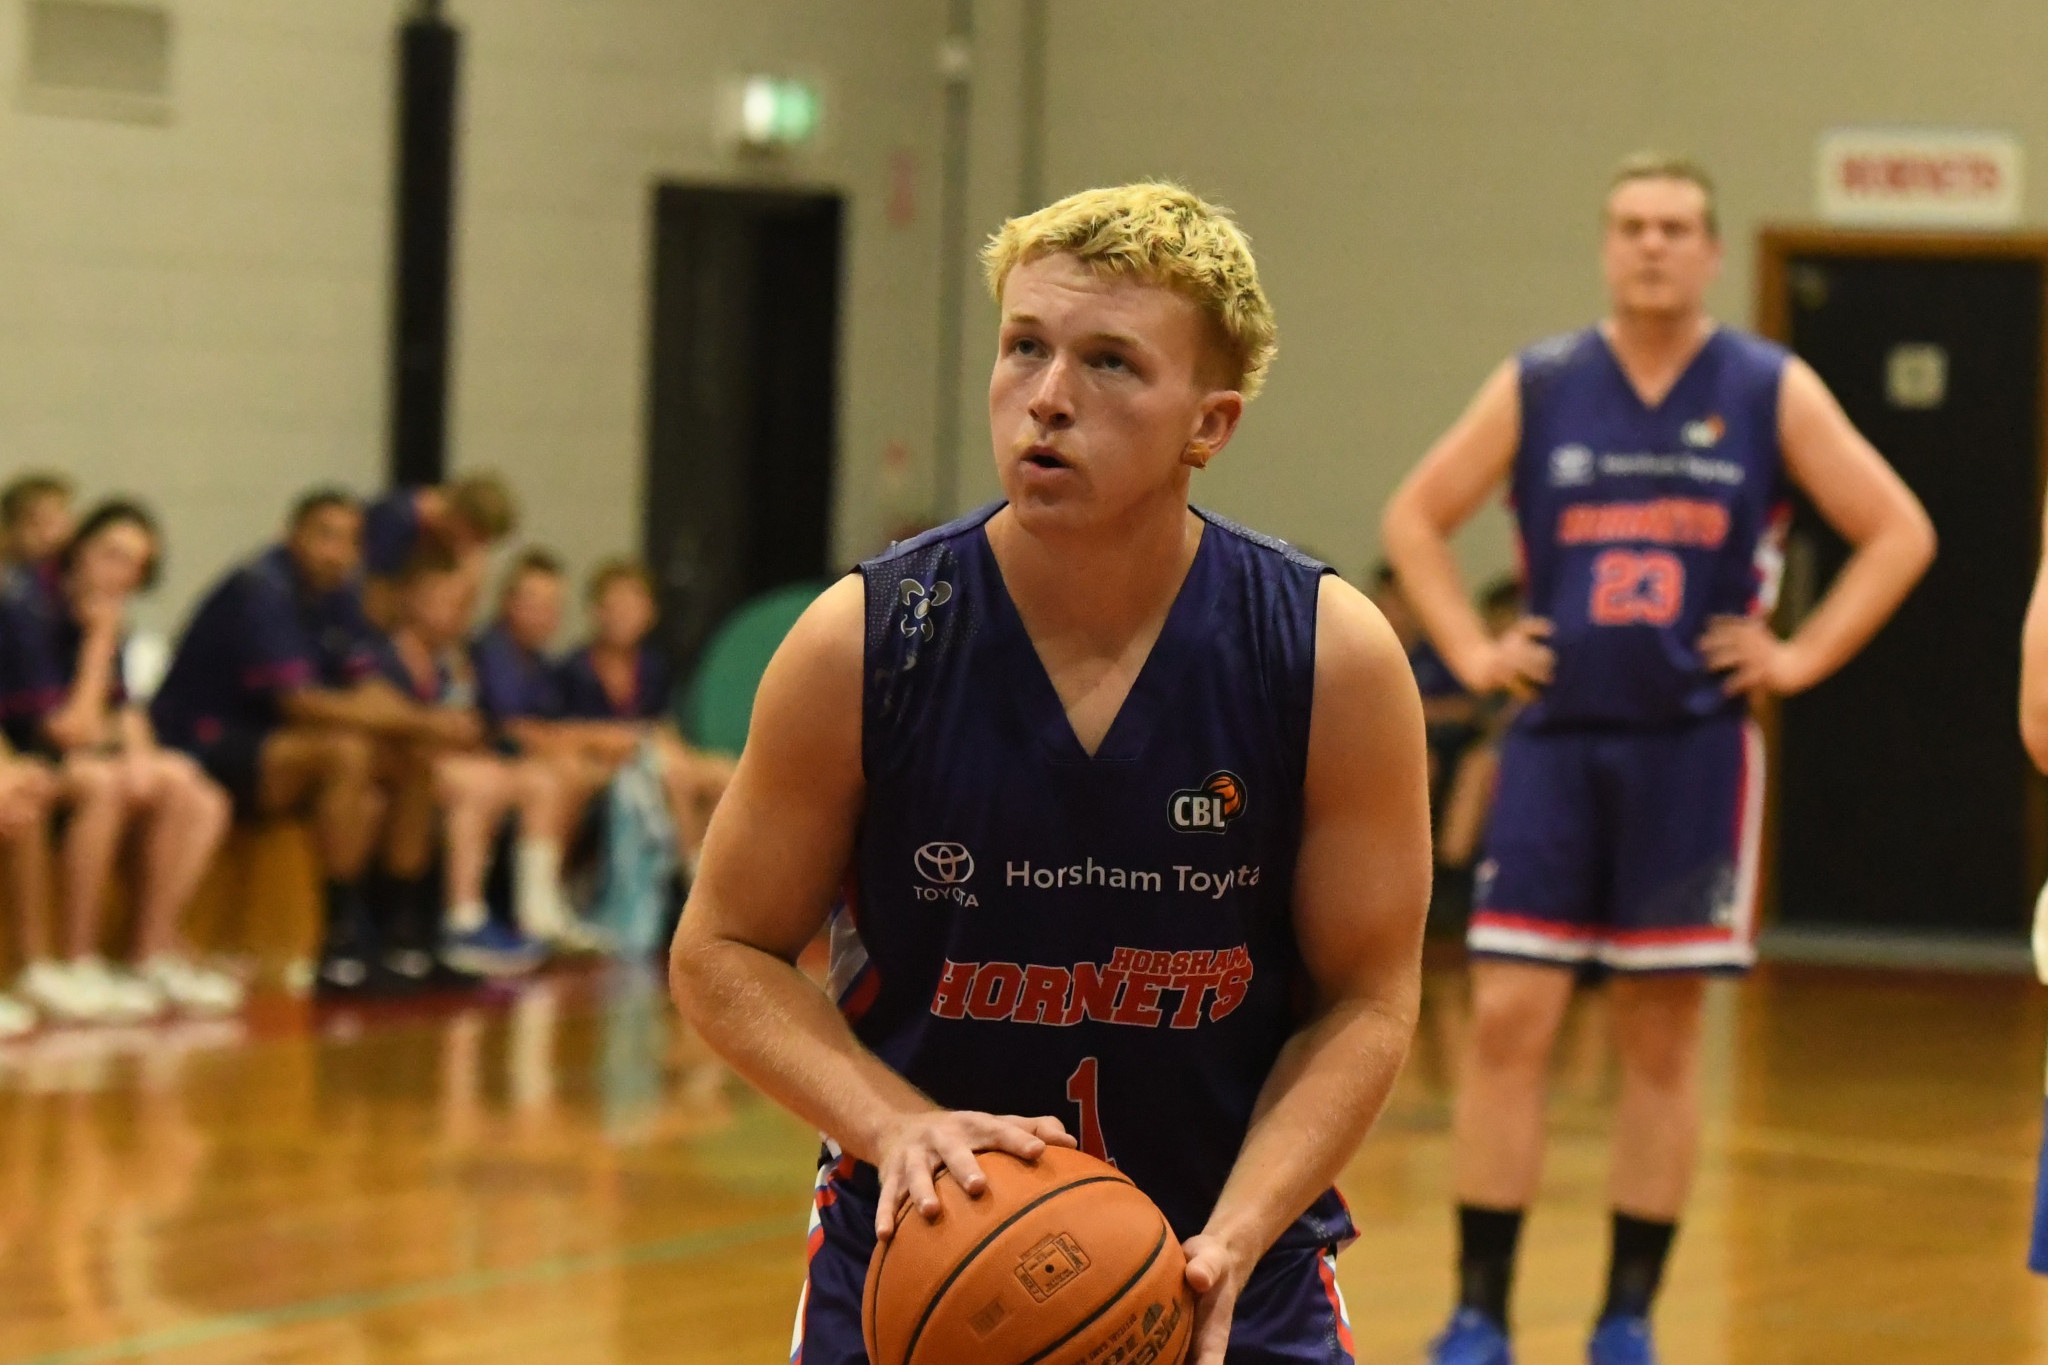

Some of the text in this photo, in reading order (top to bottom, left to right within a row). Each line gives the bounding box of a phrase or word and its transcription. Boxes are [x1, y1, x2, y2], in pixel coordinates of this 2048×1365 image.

[1591, 552, 1683, 626] 23
[1174, 796, 1225, 828] CBL
[913, 886, 979, 908] TOYOTA
[1006, 857, 1260, 899] Horsham Toyta
[1109, 943, 1250, 976] HORSHAM
[930, 958, 1253, 1029] HORNETS
[1067, 1057, 1118, 1169] 1
